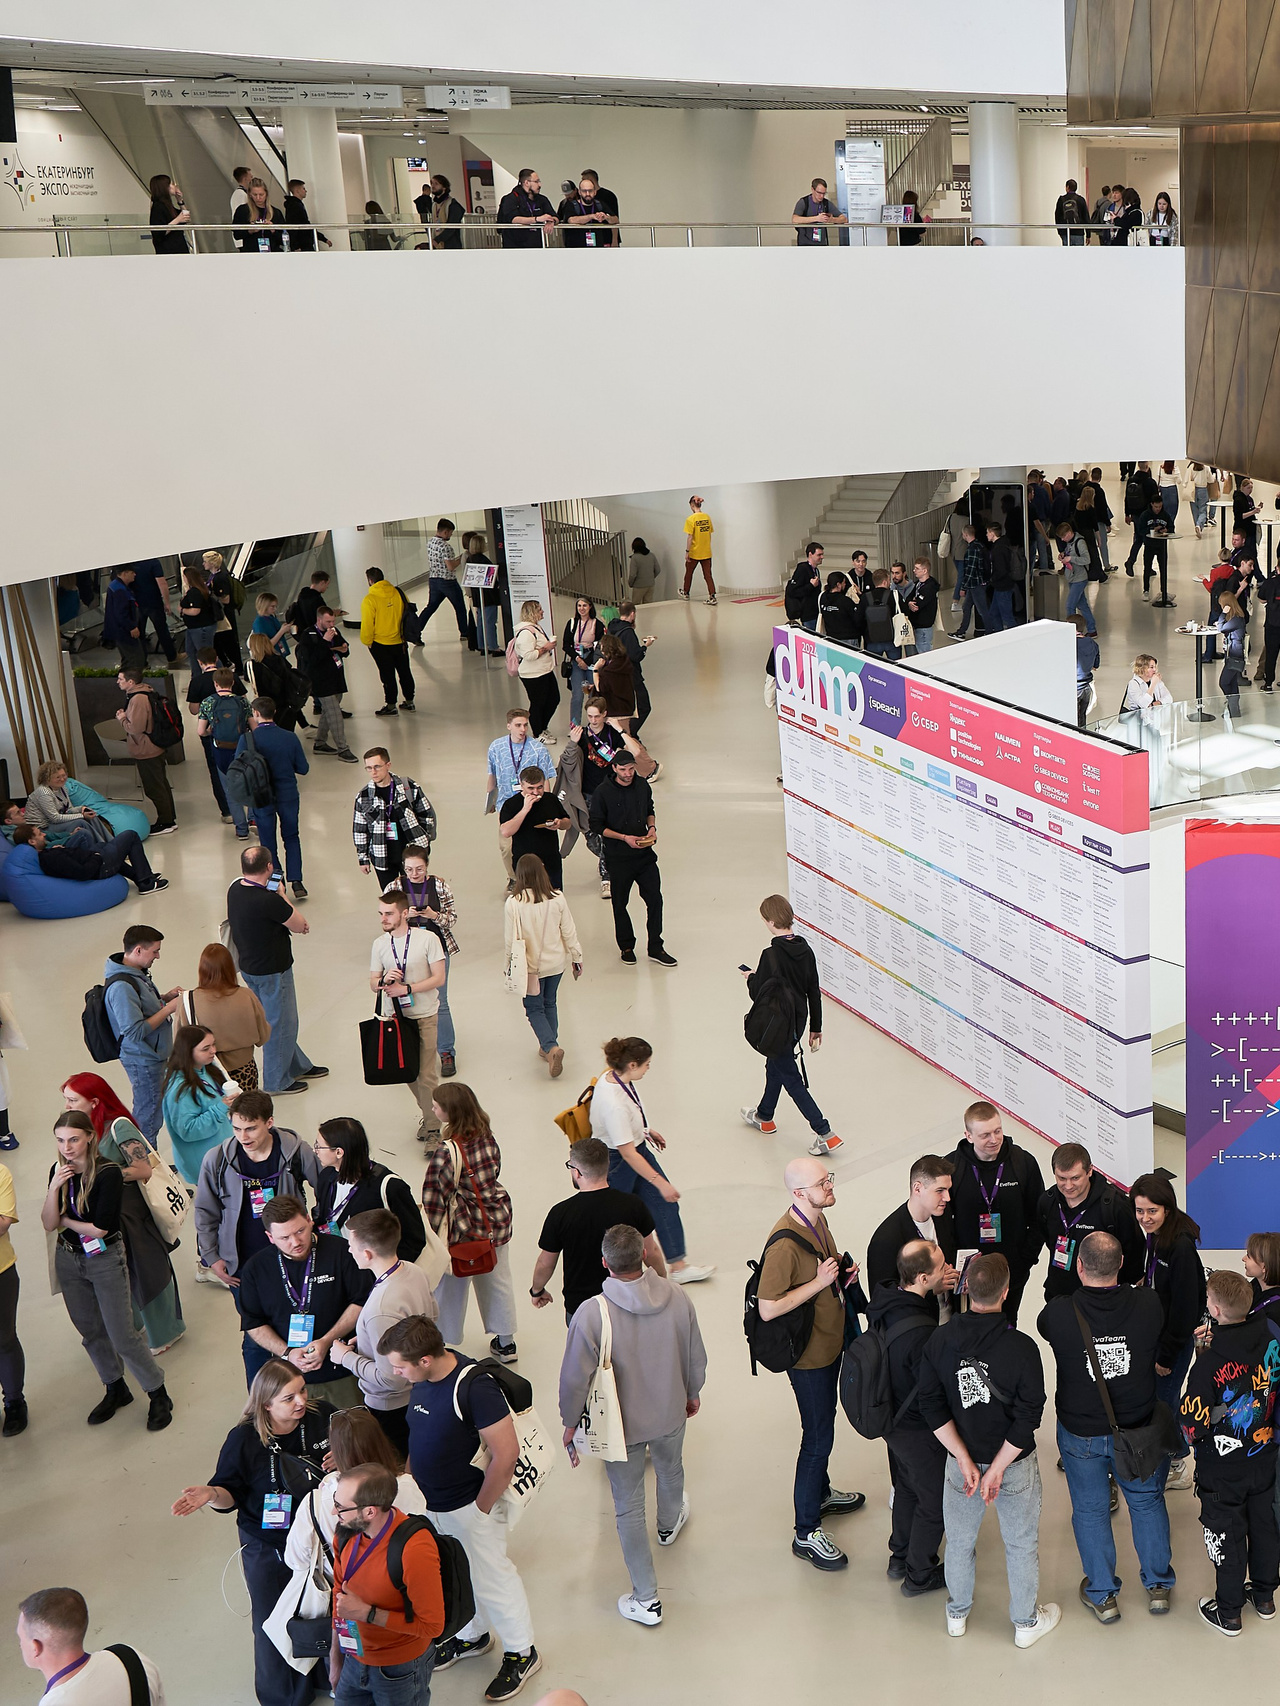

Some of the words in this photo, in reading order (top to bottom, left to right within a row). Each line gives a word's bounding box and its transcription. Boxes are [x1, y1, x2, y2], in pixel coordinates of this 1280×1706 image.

[37, 165, 94, 179] ЕКАТЕРИНБУРГ
[40, 182, 70, 195] ЭКСПО
[775, 631, 865, 724] dump
[920, 717, 939, 732] СБЕР
[949, 712, 966, 727] Яндекс
[994, 731, 1022, 748] NAUMEN
[1003, 752, 1022, 764] АСТРА
[1082, 799, 1100, 811] evrone
[1092, 1335, 1127, 1344] EvaTeam
